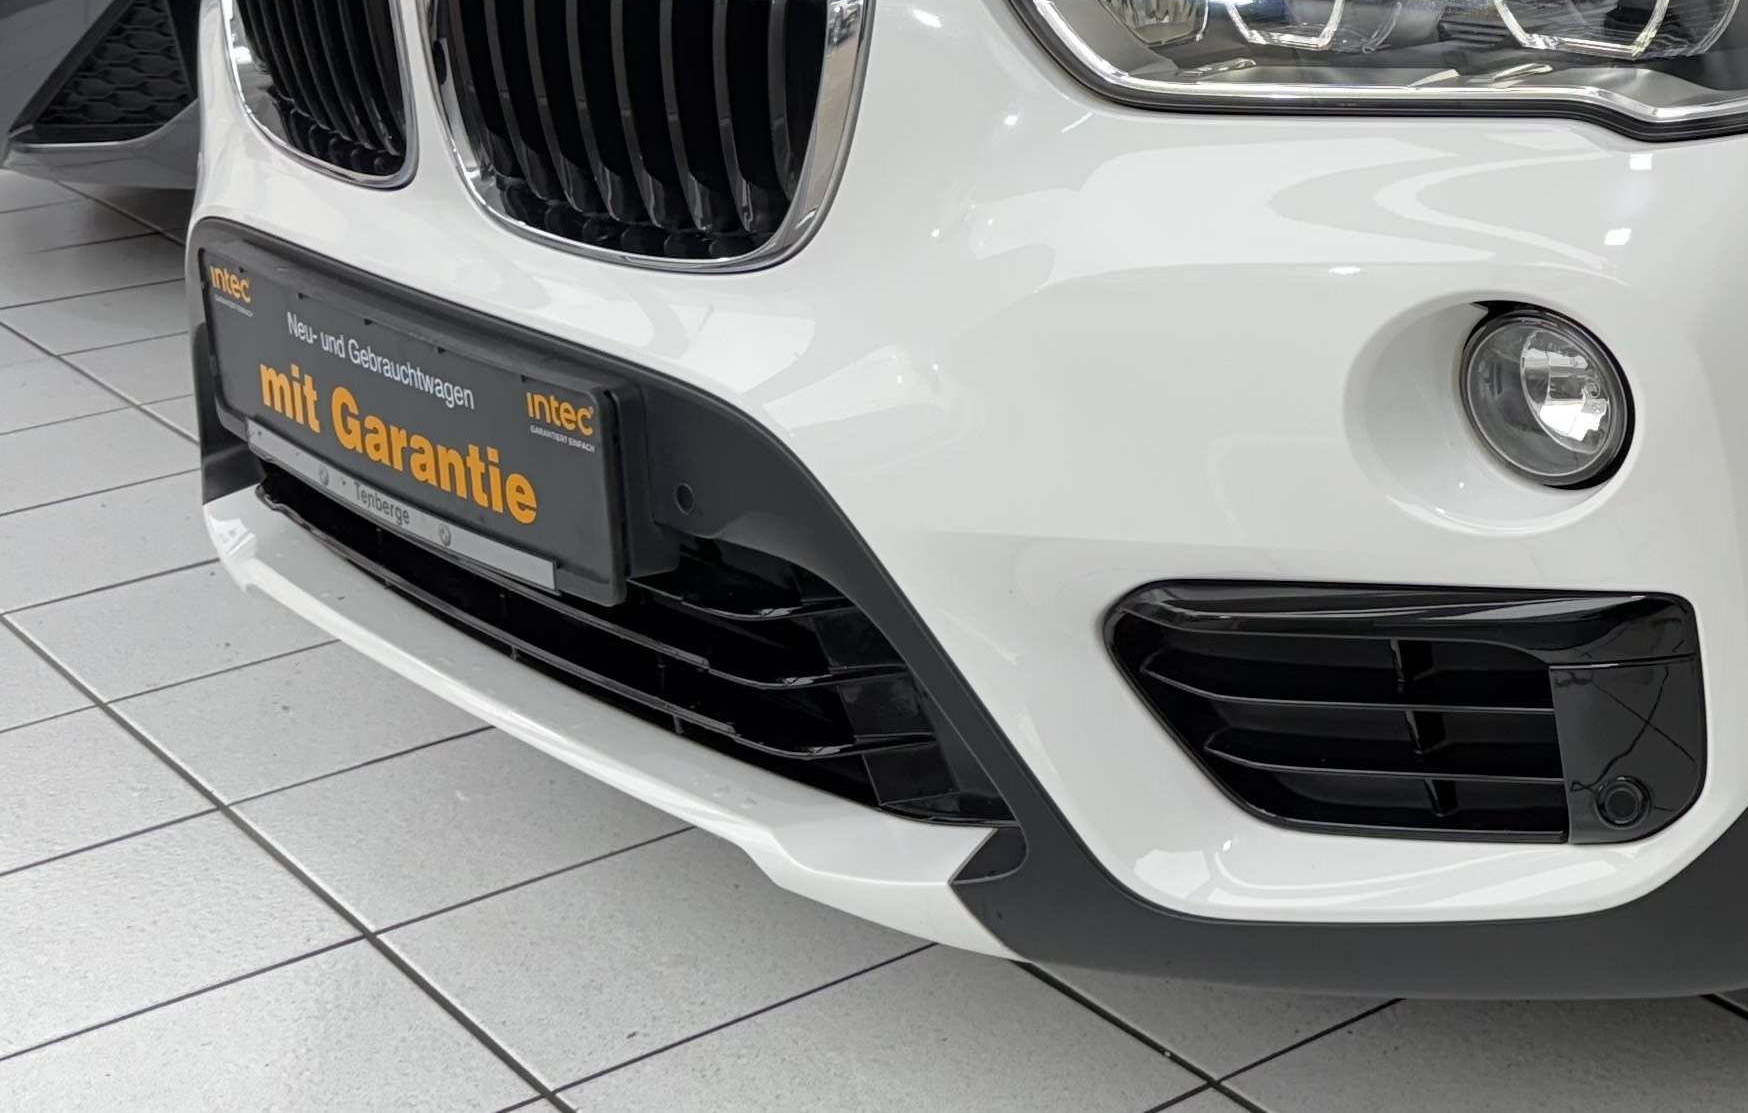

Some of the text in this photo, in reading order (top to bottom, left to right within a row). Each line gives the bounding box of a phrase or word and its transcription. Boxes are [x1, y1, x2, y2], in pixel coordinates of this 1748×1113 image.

[287, 312, 475, 410] Neu- und Gebrauchtwagen
[260, 363, 537, 524] mit Garantie
